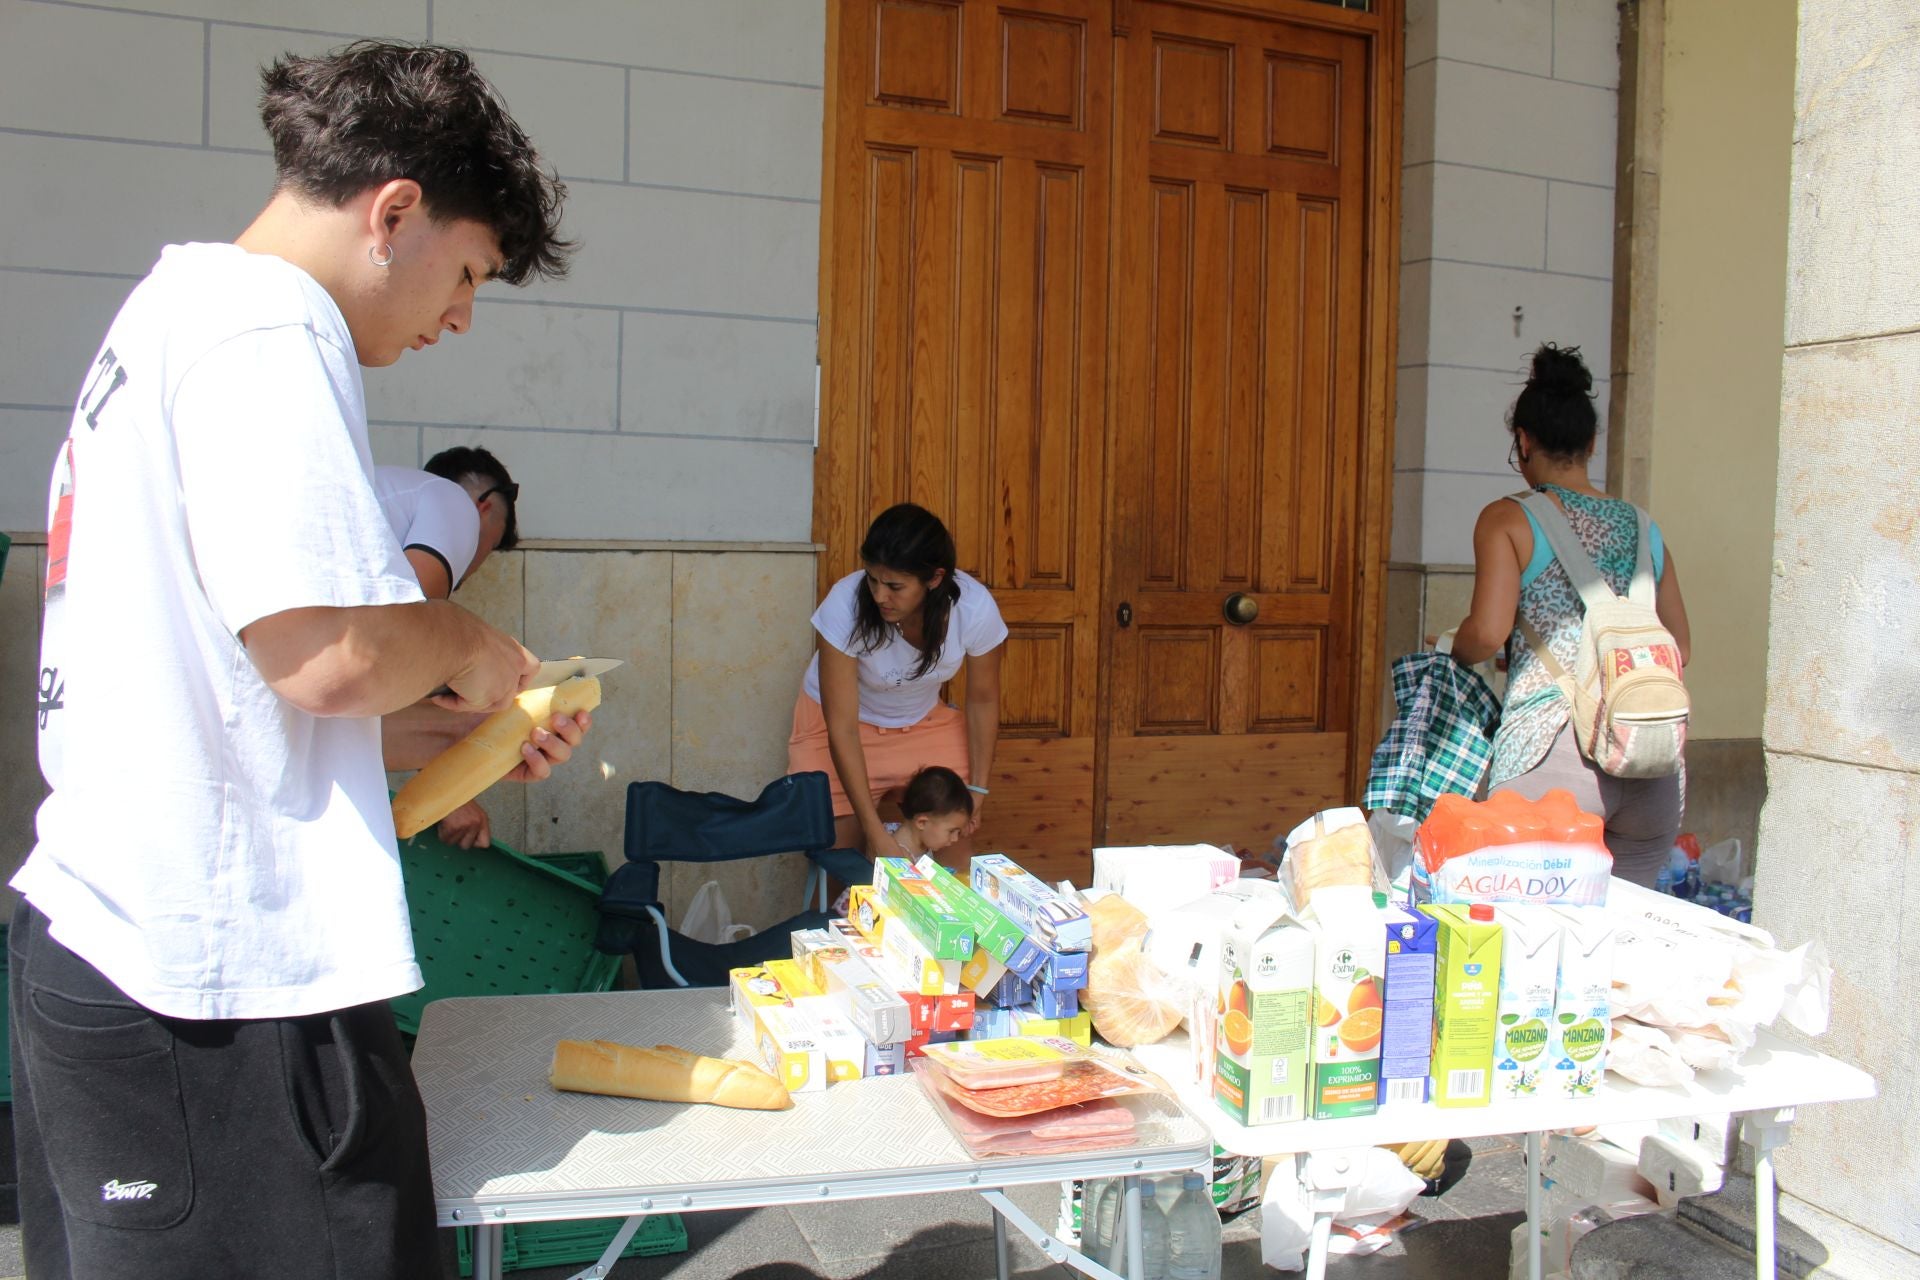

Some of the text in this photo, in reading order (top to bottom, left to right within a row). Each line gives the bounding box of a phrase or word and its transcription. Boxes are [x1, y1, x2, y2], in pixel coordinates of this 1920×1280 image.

[1543, 857, 1572, 870] Débil
[1331, 963, 1356, 974] Extra
[1504, 1028, 1548, 1044] MANZANA
[1562, 1028, 1605, 1044] MANZANA
[1341, 1065, 1362, 1075] 100%
[1328, 1072, 1372, 1085] EXPRIMIDO
